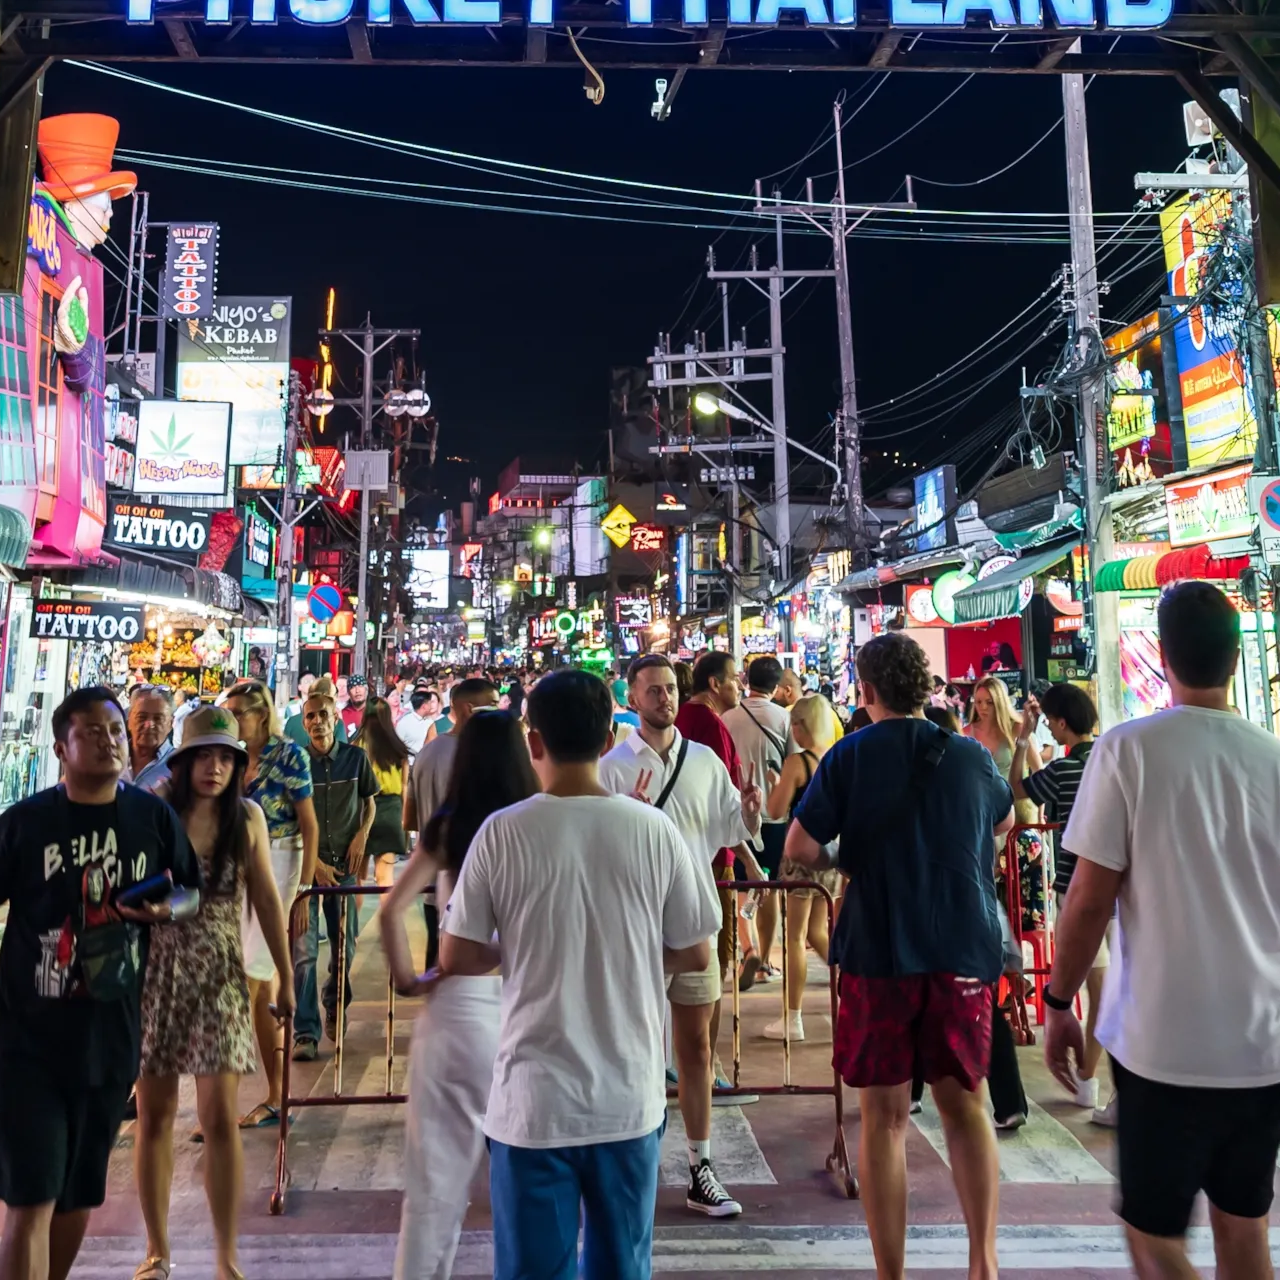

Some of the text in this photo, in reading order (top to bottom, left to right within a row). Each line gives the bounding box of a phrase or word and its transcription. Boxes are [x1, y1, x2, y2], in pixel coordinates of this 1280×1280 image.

[204, 326, 277, 344] KEBAB
[113, 514, 206, 549] TATTOO
[36, 613, 139, 640] TATTOO
